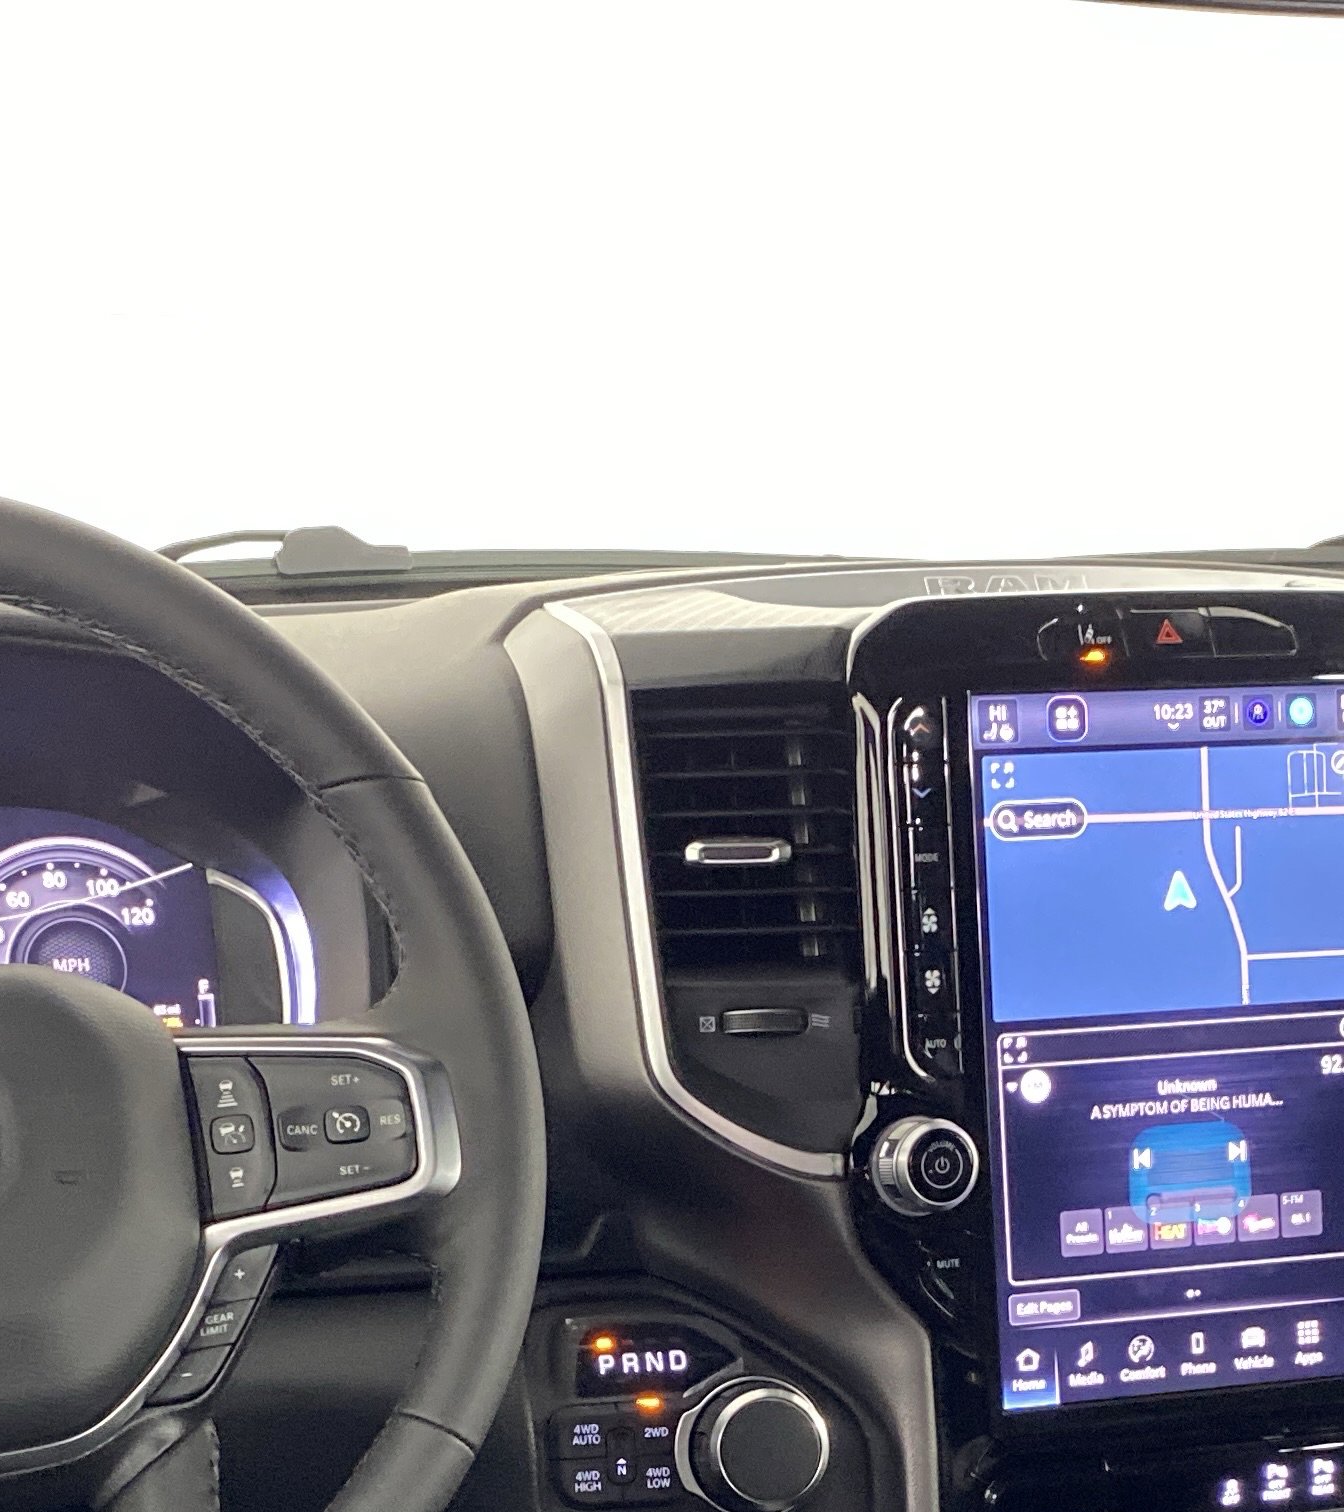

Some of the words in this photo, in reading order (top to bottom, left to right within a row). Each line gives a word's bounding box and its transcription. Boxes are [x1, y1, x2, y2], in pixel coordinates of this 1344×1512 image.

[1154, 703, 1194, 720] 10:23
[1203, 715, 1227, 729] OUT
[1024, 808, 1077, 829] Search
[41, 870, 68, 889] 80
[86, 879, 121, 898] 100
[5, 890, 31, 910] 60
[121, 906, 156, 926] 120
[52, 957, 91, 972] MPH
[925, 1038, 947, 1050] AUTO
[1158, 1078, 1218, 1096] Unknown
[1090, 1104, 1103, 1120] A
[1102, 1101, 1169, 1118] SYMPTOM
[1170, 1098, 1189, 1113] OF
[1190, 1096, 1231, 1112] BEING
[379, 1113, 402, 1126] RES
[286, 1123, 319, 1136] CANC
[936, 1257, 960, 1269] MUTE
[205, 1311, 234, 1325] GEAR
[200, 1323, 229, 1337] LIMIT
[1233, 1354, 1275, 1371] Vehicle
[1294, 1351, 1324, 1367] Apps
[1119, 1365, 1167, 1382] Comfort
[1180, 1361, 1217, 1377] Phone
[1012, 1378, 1047, 1393] Home
[1068, 1370, 1105, 1387] Media
[573, 1423, 600, 1435] 4WD
[643, 1426, 669, 1439] 2WD
[572, 1433, 602, 1446] AUTO
[575, 1470, 601, 1482] 4WD
[616, 1465, 628, 1476] N
[645, 1466, 671, 1478] 4WD
[574, 1480, 602, 1493] HIGH
[646, 1477, 671, 1490] LOW
